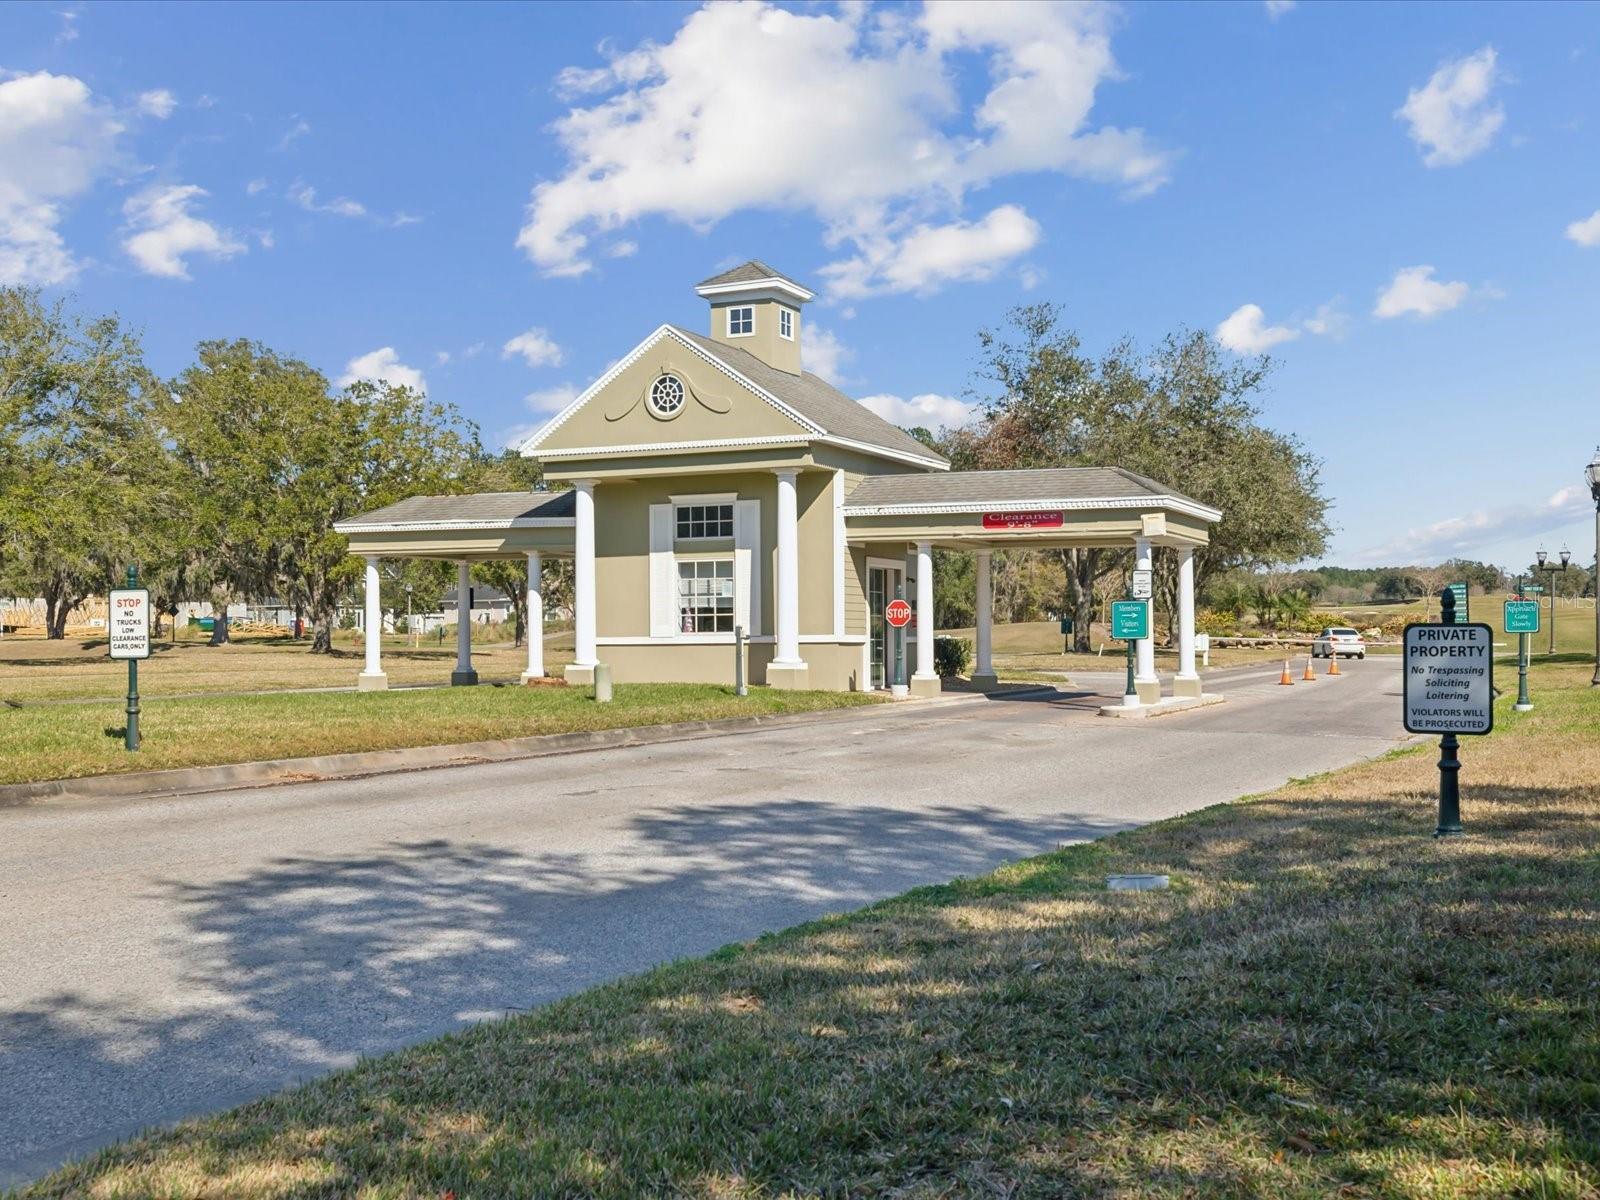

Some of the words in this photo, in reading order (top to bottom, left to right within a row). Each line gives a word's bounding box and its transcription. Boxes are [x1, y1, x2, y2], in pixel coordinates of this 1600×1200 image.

[989, 513, 1057, 521] Clearance
[117, 599, 141, 608] STOP
[1118, 604, 1141, 612] Members
[888, 609, 910, 619] STOP
[1418, 629, 1476, 640] PRIVATE
[1410, 646, 1485, 657] PROPERTY
[1411, 666, 1425, 675] No
[1428, 666, 1484, 677] Trespassing
[1425, 679, 1470, 689] Soliciting
[1426, 692, 1470, 702] Loitering
[1411, 708, 1461, 717] VIOLATORS
[1463, 709, 1485, 717] WILL
[1412, 720, 1423, 728] BE
[1425, 720, 1484, 729] PROSECUTED
